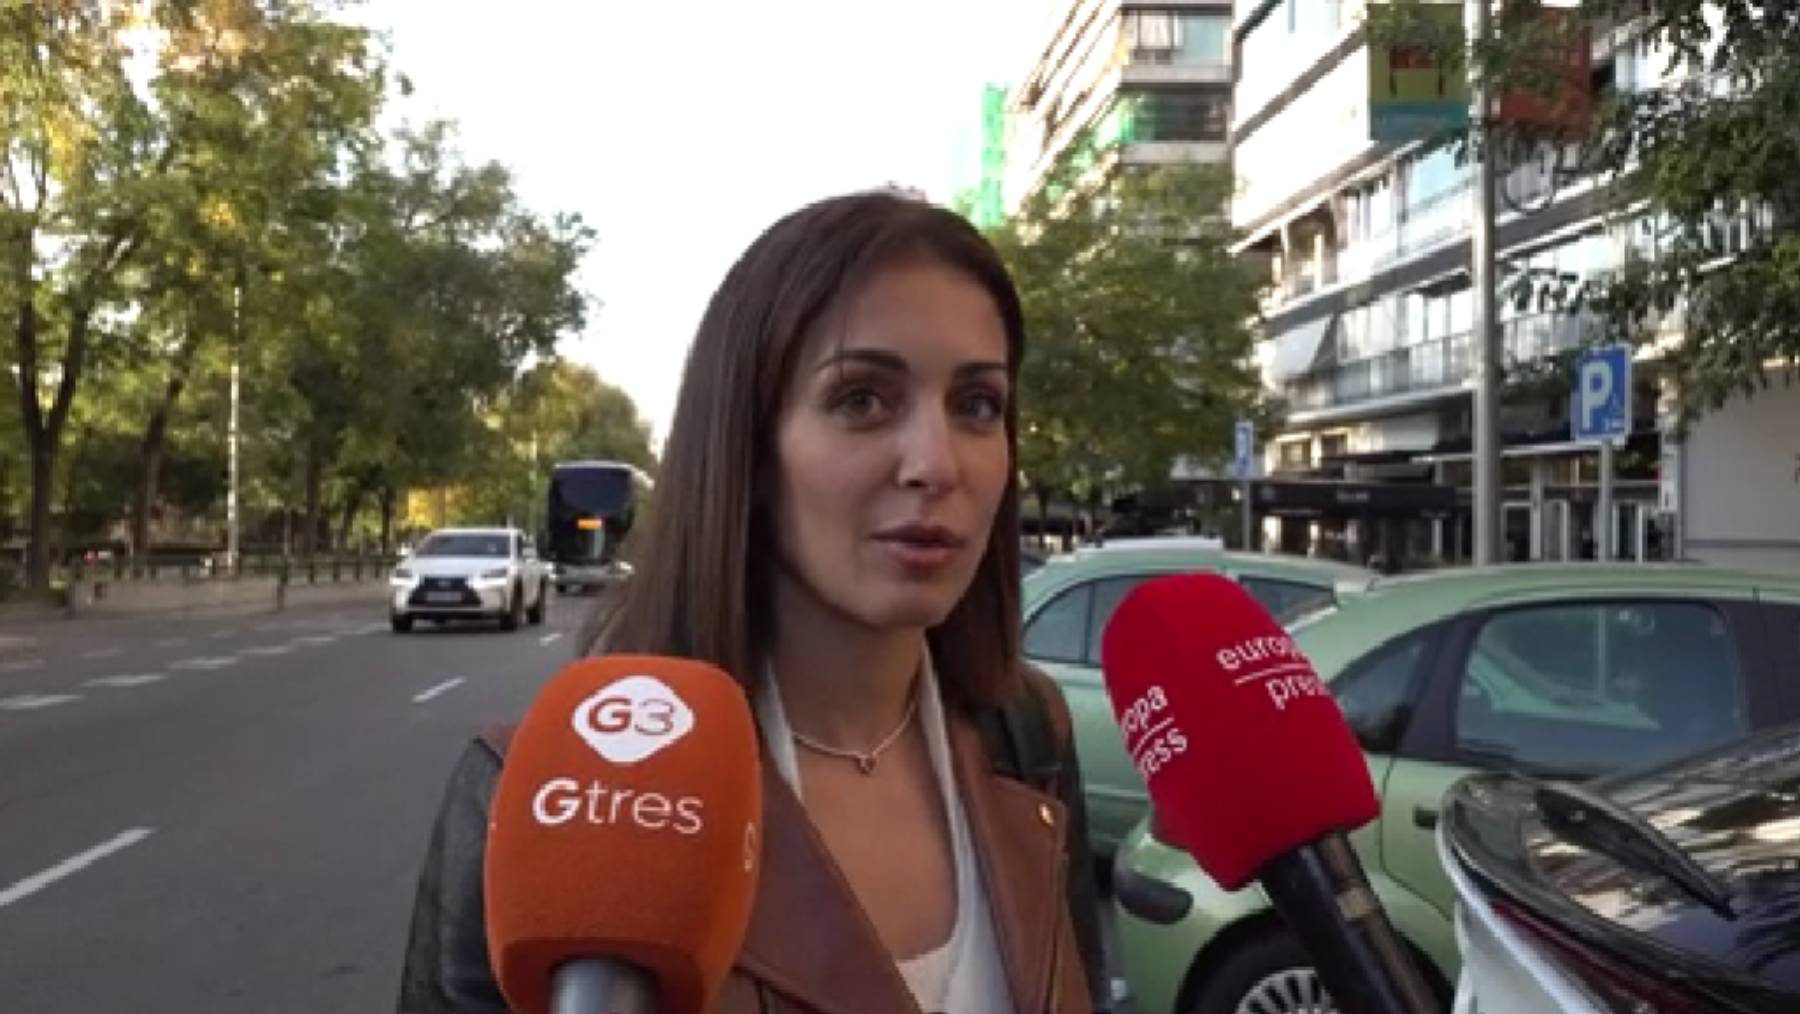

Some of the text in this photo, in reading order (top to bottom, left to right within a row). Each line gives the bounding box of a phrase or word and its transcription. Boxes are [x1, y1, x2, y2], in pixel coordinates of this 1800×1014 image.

[1582, 361, 1612, 431] P
[588, 697, 675, 736] G3
[533, 777, 704, 834] Gtres
